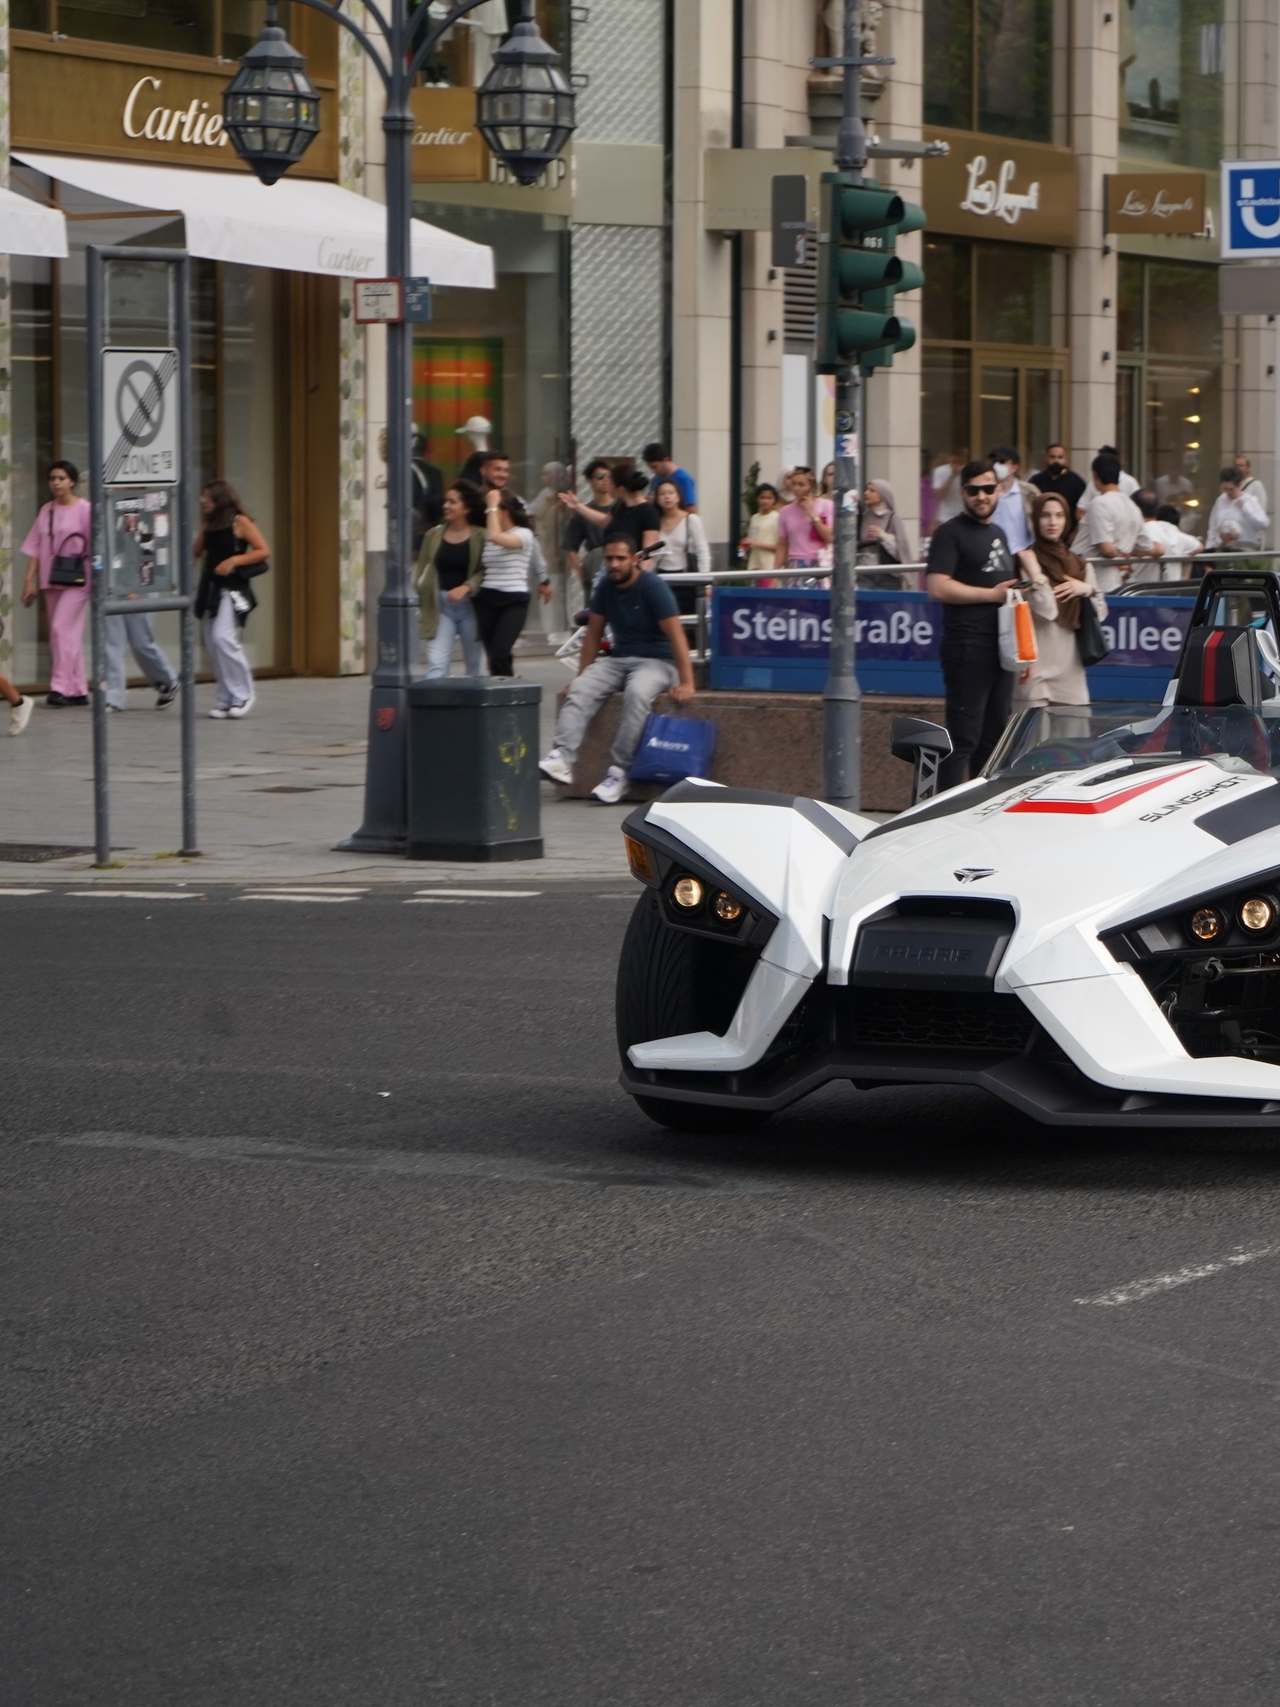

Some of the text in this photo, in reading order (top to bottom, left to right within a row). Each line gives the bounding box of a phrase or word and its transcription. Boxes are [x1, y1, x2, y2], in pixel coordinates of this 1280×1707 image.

[411, 125, 474, 146] artier
[317, 235, 375, 273] Cartier
[121, 453, 161, 475] ZONE
[732, 608, 934, 646] Steinsraße
[1138, 775, 1249, 823] SLINGSHOT
[872, 945, 975, 963] POLARIS
